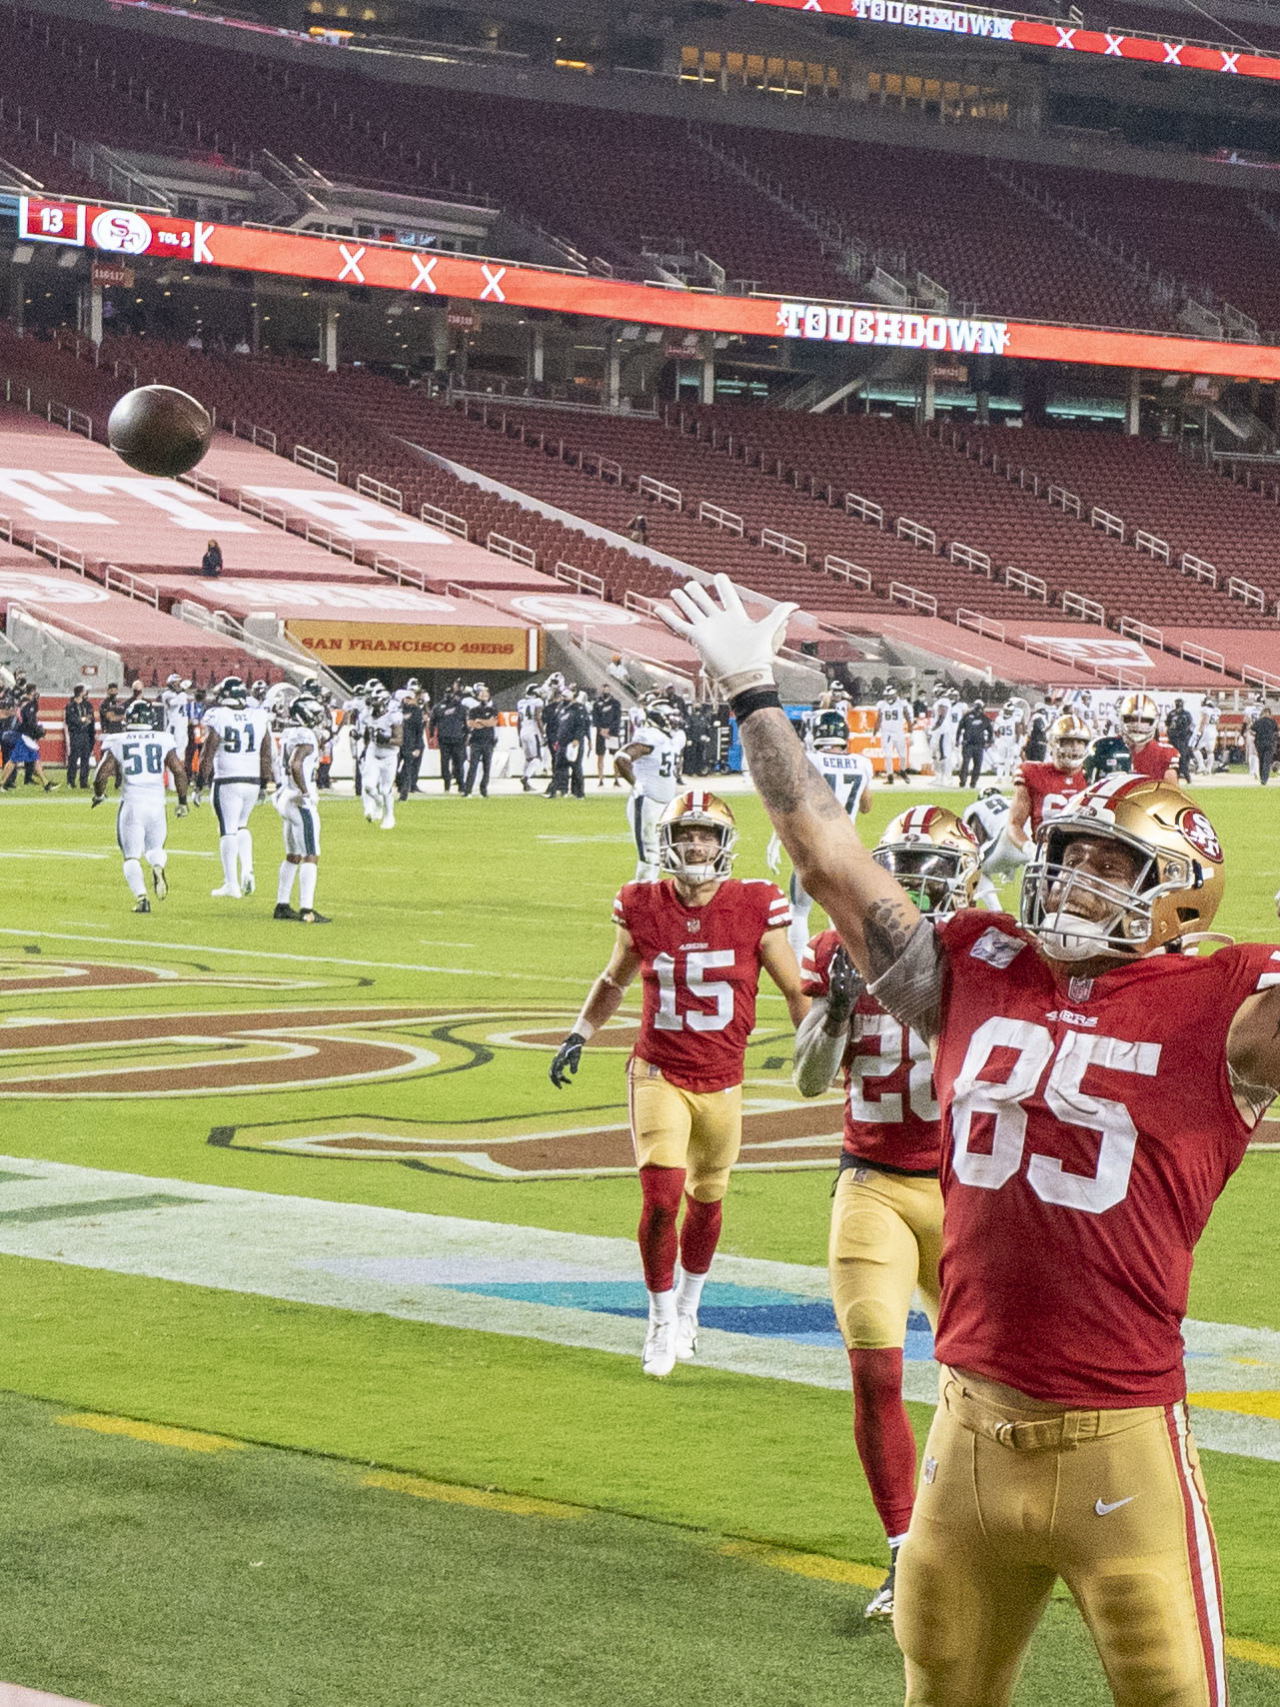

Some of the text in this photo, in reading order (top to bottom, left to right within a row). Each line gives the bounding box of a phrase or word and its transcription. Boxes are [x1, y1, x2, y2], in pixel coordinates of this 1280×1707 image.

[40, 207, 63, 233] 13
[781, 303, 1007, 354] TOUCHDOWN
[302, 637, 515, 655] SAN FRANCISCO 49ERS
[224, 723, 256, 754] 91
[122, 743, 163, 776] 58
[823, 757, 858, 769] GERRY
[651, 949, 736, 1032] 15
[952, 1016, 1163, 1214] 85
